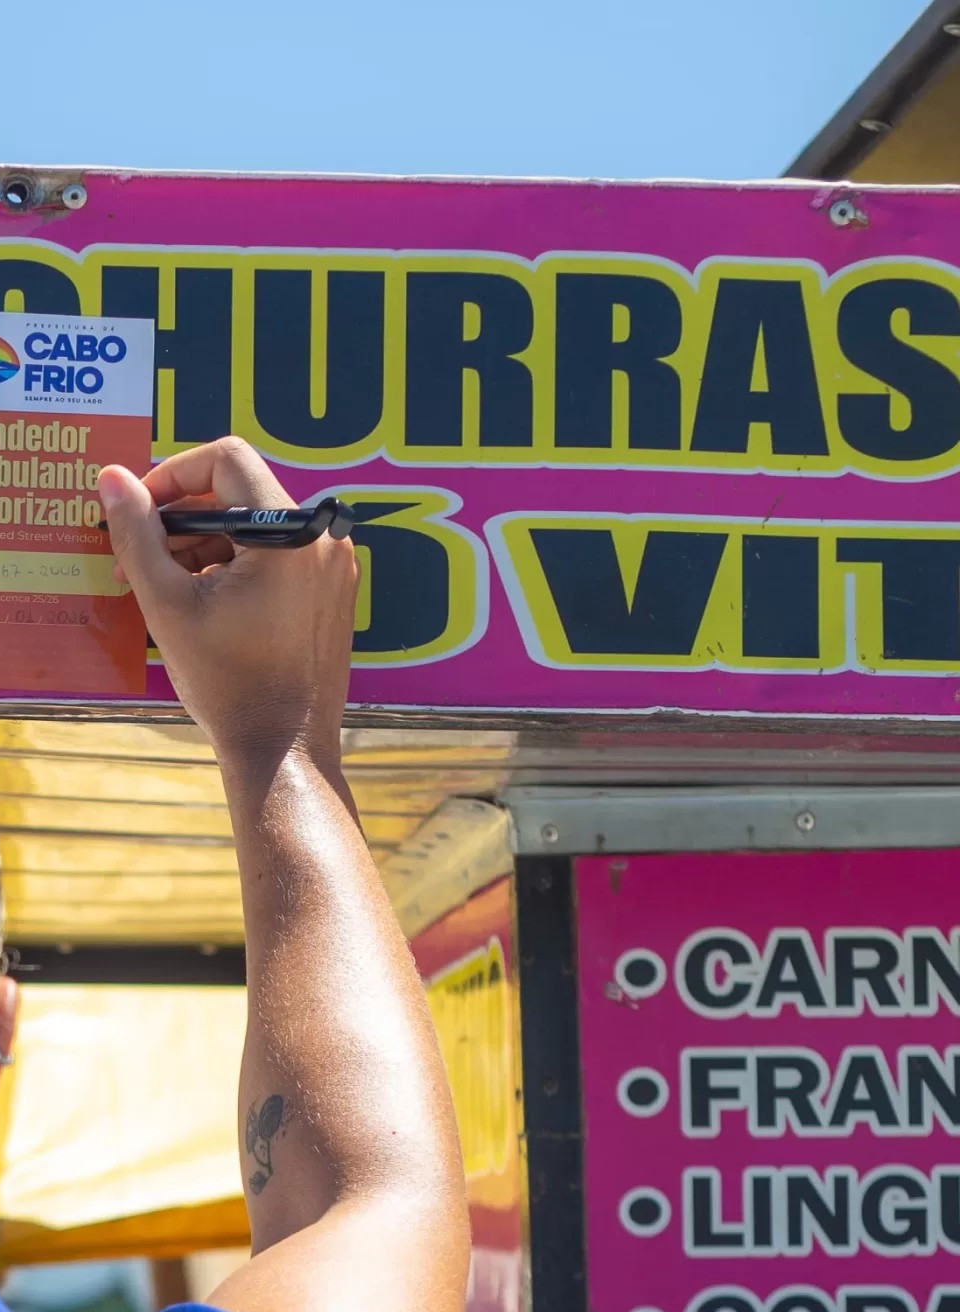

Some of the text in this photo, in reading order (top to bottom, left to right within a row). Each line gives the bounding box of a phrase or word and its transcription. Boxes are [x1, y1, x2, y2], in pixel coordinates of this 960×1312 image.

[24, 331, 127, 364] CABO
[24, 363, 104, 395] FRIO
[24, 395, 52, 403] SEMPRE
[17, 530, 53, 542] Street
[56, 532, 104, 545] Vendor)
[685, 936, 960, 1009] CARN
[690, 1055, 960, 1128] FRAN
